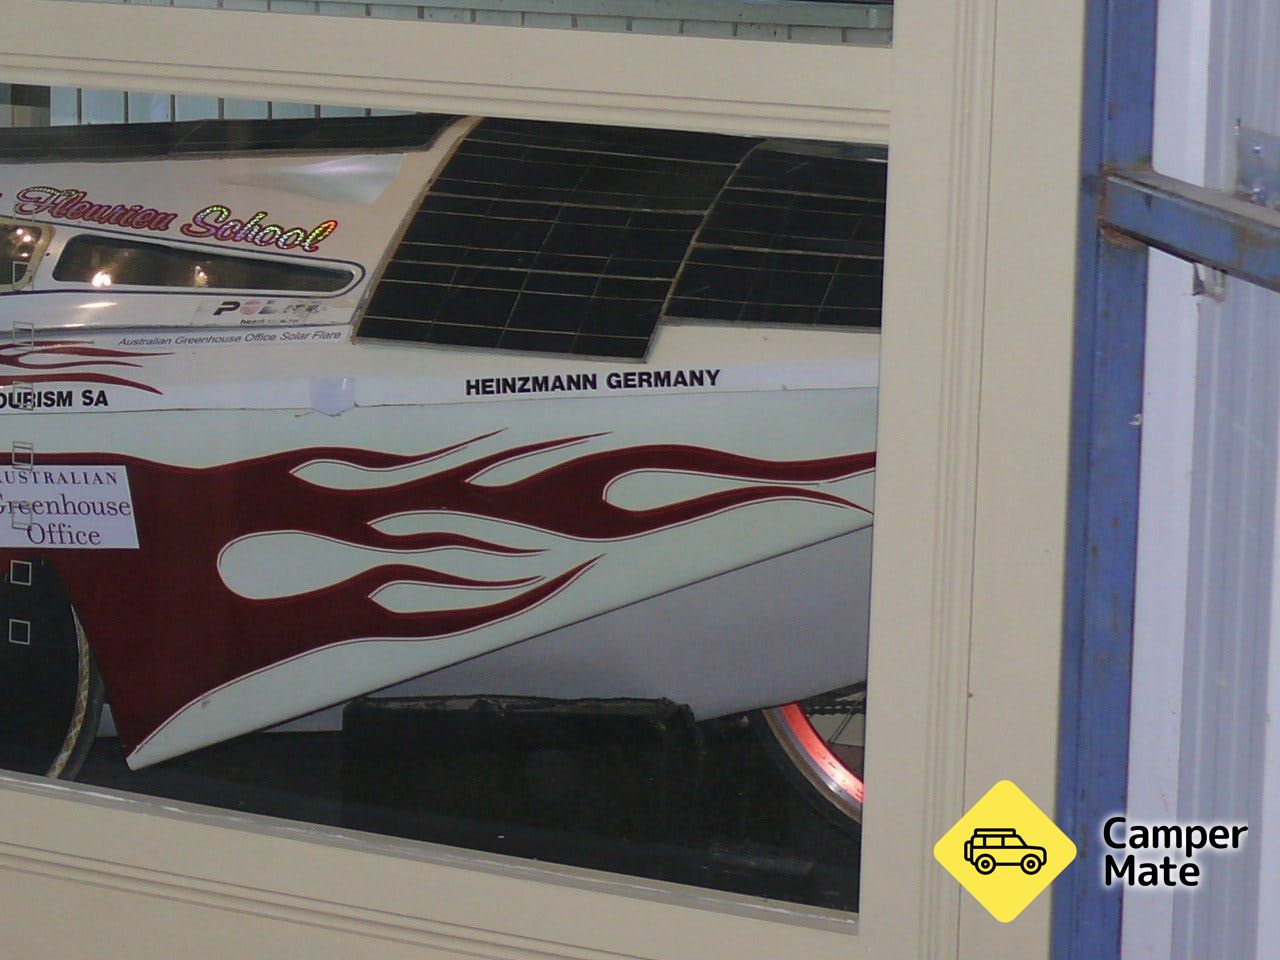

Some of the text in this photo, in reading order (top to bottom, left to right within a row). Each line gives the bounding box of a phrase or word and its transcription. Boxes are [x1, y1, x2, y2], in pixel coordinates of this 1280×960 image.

[15, 186, 178, 232] Fleurieu
[180, 204, 337, 253] School
[119, 331, 341, 345] Australian Greenhouse Office Solar Flare
[465, 369, 720, 395] HEINZMANN GERMANY
[82, 390, 108, 406] SA
[28, 523, 101, 544] Office
